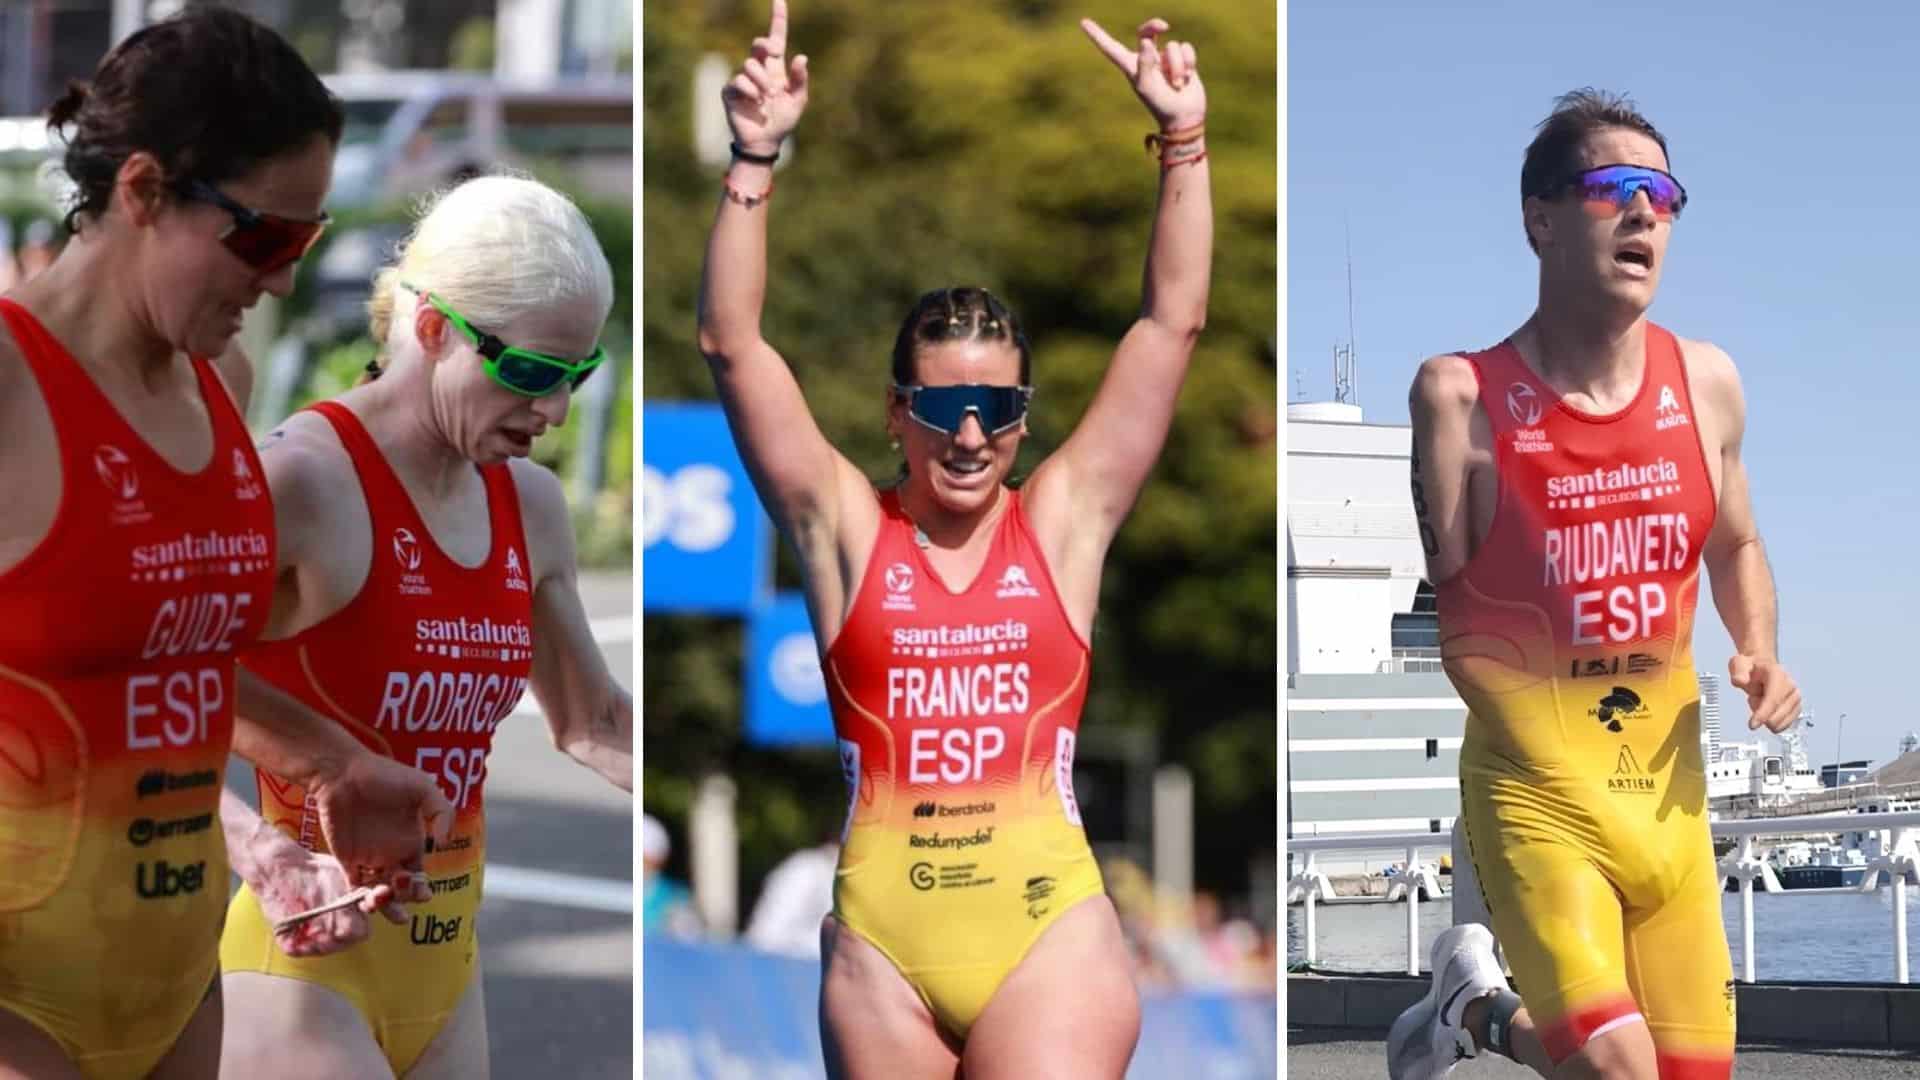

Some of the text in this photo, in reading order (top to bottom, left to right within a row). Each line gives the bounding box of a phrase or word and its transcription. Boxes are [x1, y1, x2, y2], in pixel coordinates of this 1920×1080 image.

[1543, 512, 1690, 587] RIUDAVETS
[141, 593, 251, 660] GUIDE
[1571, 581, 1667, 646] ESP
[126, 668, 224, 749] ESP
[887, 662, 1030, 719] FRANCES
[415, 747, 484, 808] ESP
[909, 726, 1006, 785] ESP
[1607, 778, 1656, 790] ARTIEM
[136, 860, 206, 899] Uber
[410, 915, 462, 944] Uber
